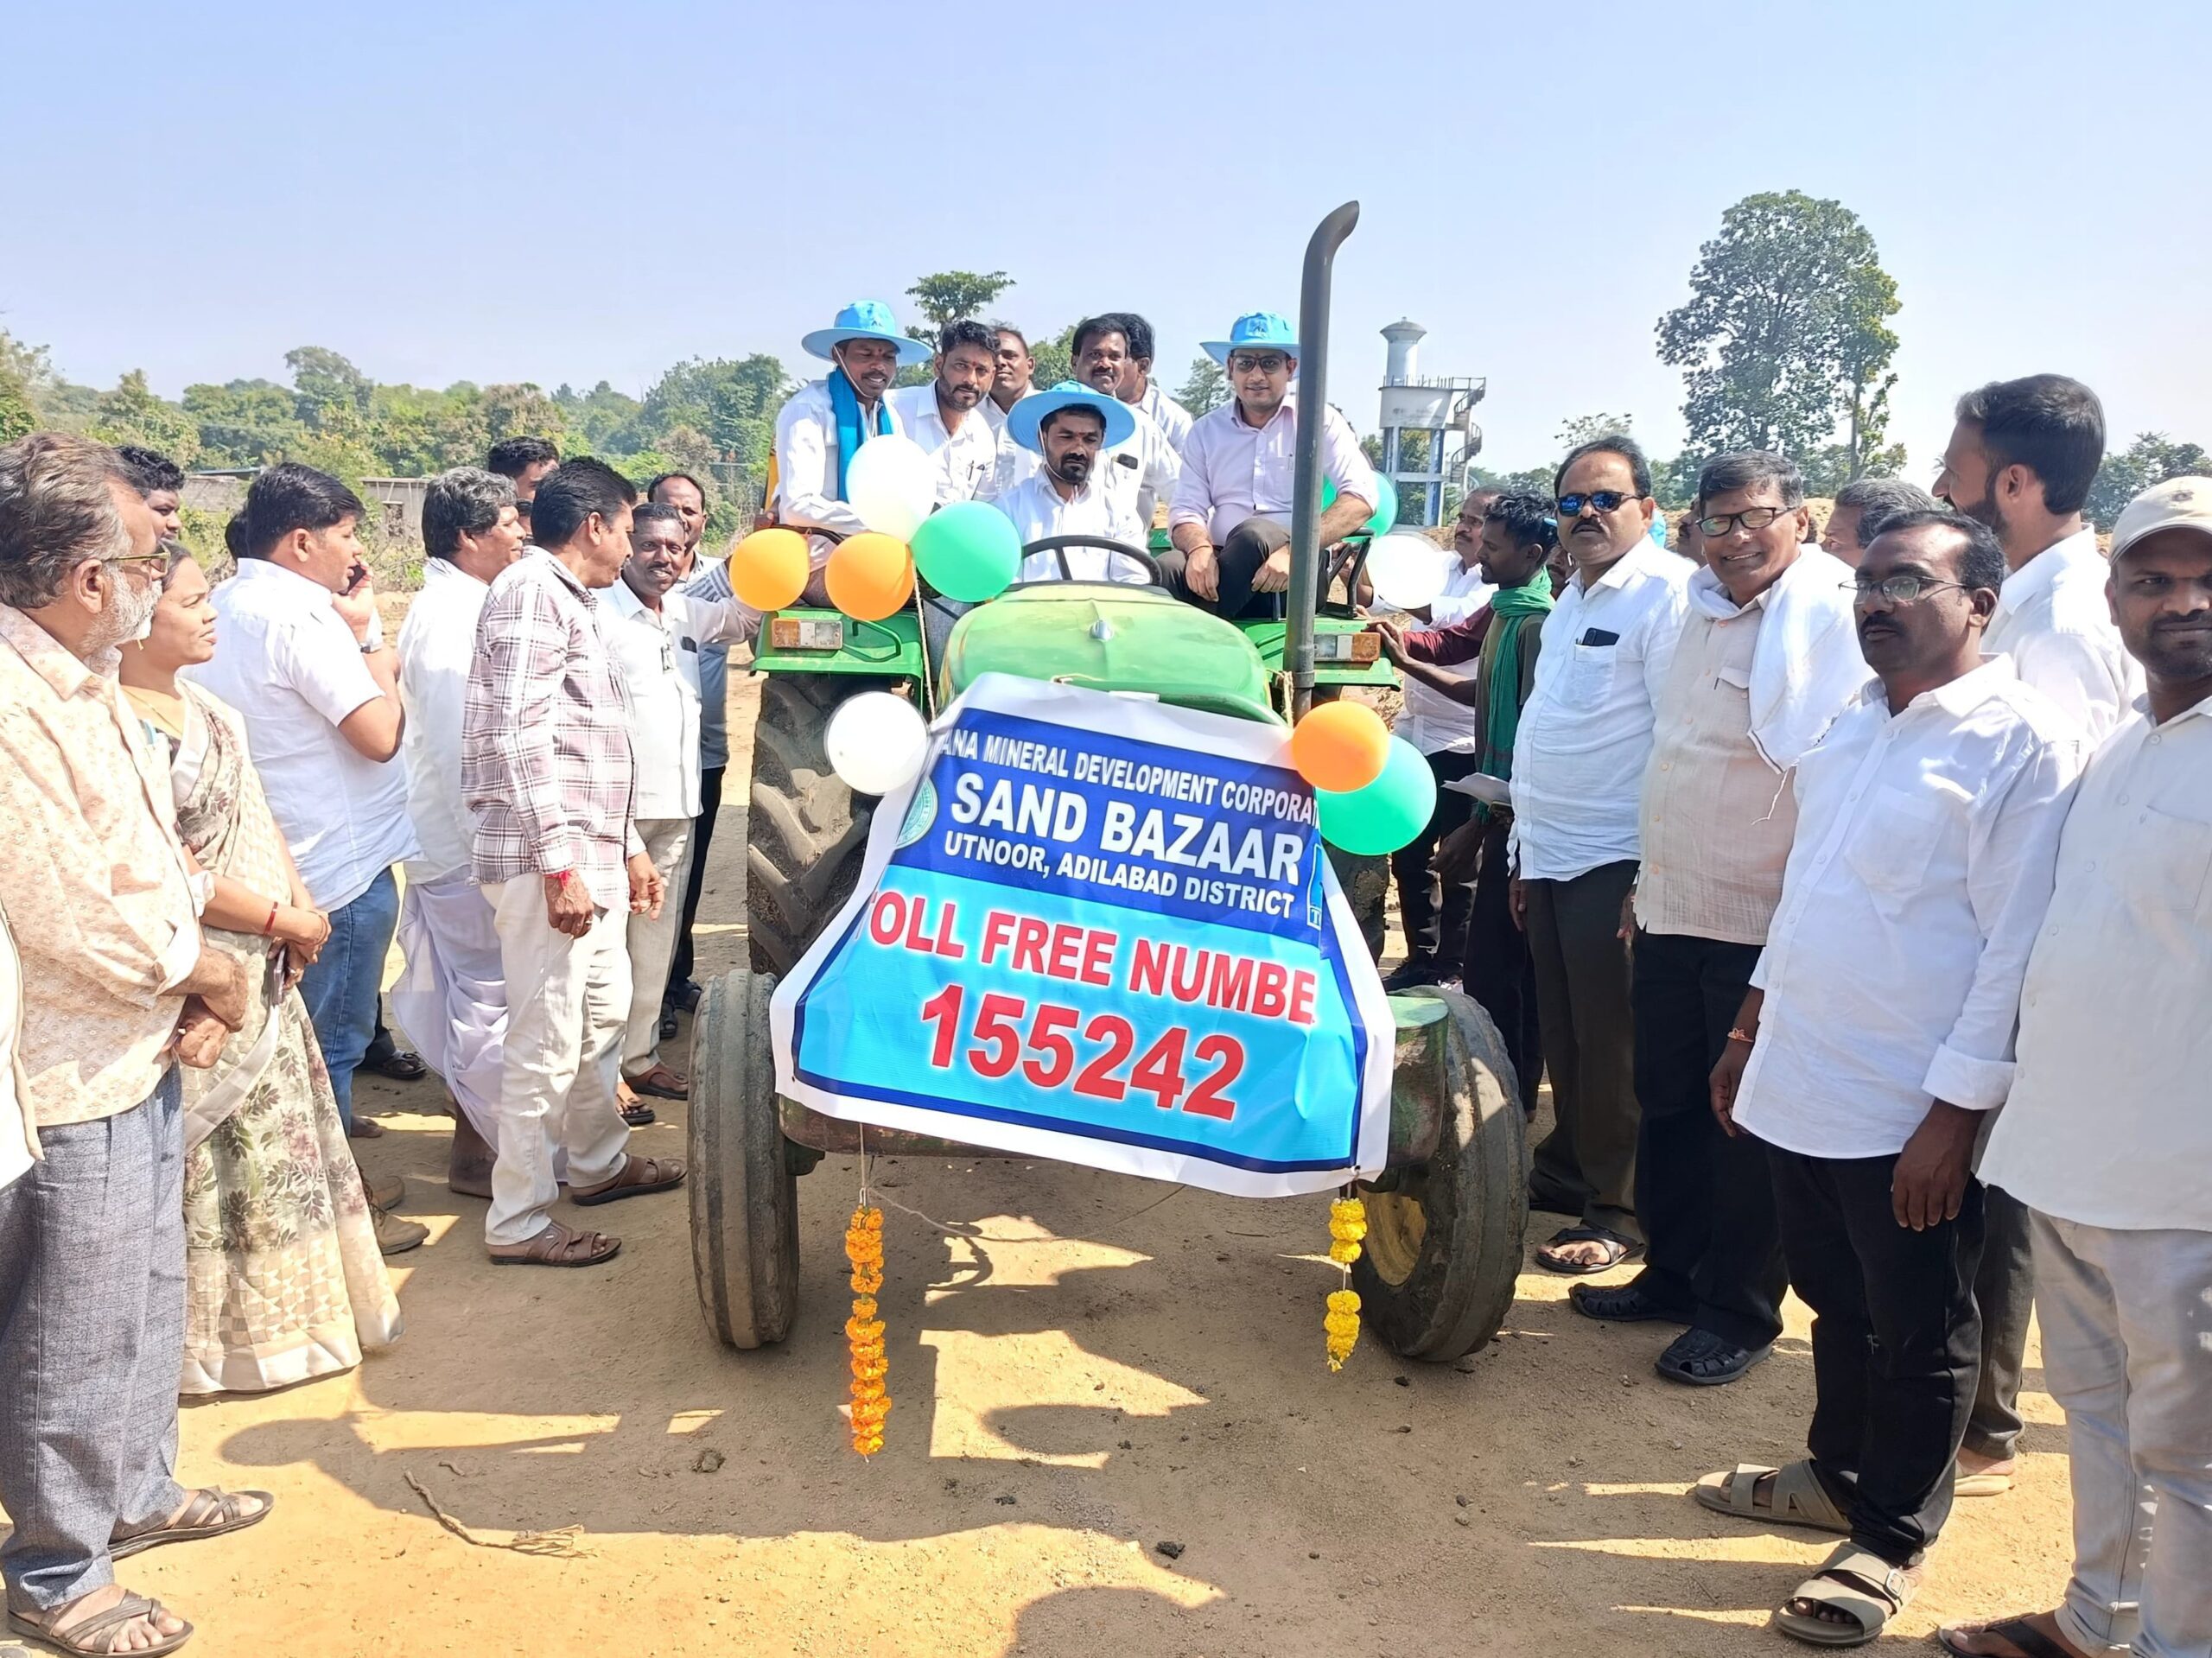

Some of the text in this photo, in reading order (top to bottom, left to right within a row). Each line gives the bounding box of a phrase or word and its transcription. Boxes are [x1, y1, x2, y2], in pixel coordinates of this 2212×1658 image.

[982, 734, 1070, 778] MINERAL
[1073, 751, 1220, 805] DEVELOPMENT
[944, 829, 1295, 919] UTNOOR, ADILABAD DISTRICT
[950, 772, 1088, 843] SAND
[1098, 799, 1304, 886] BAZAAR
[869, 891, 1316, 1026] OLL FREE NUMBE
[921, 983, 1244, 1121] 155242
